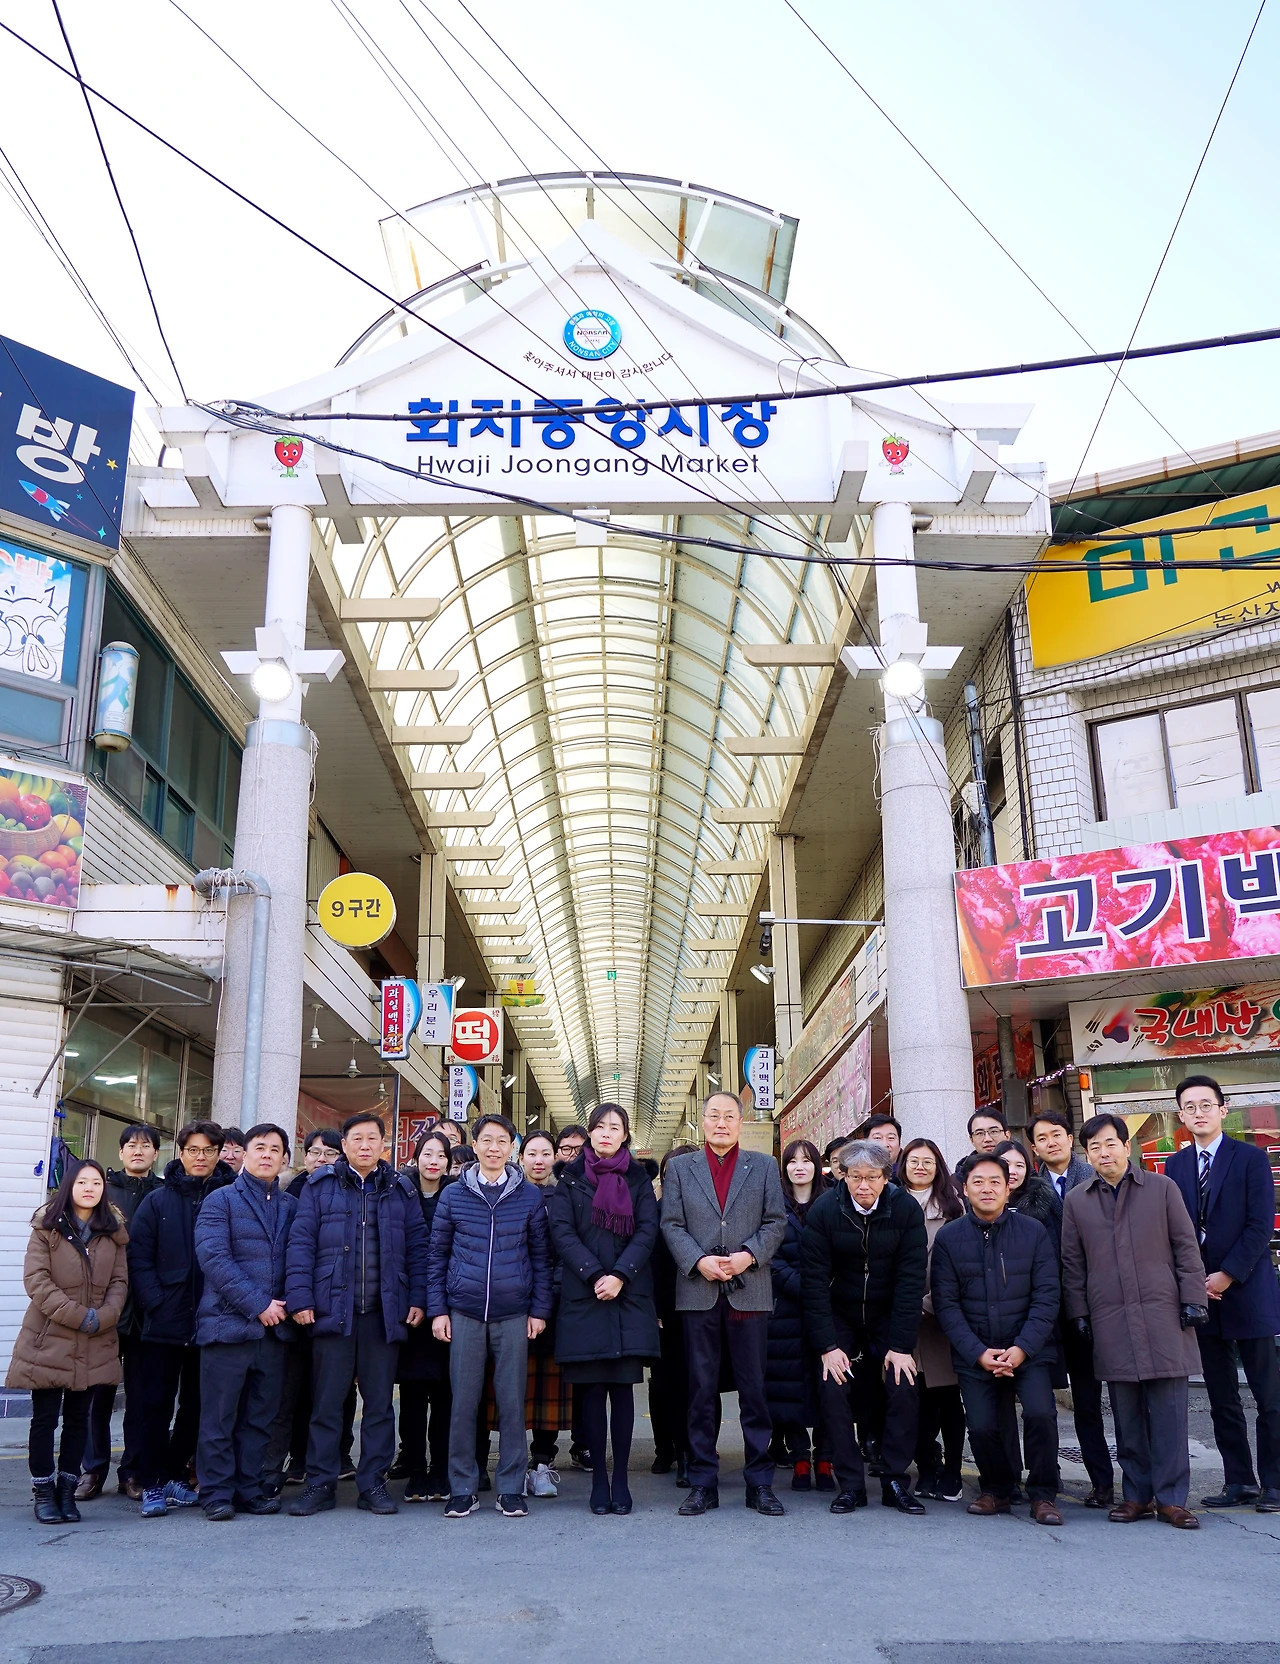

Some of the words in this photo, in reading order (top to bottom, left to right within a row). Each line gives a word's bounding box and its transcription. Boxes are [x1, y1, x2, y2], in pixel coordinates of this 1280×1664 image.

[523, 350, 576, 379] 찾아주셔서
[620, 352, 673, 379] 감사합니다
[568, 340, 602, 357] NONSAN
[601, 340, 617, 355] CITY
[16, 403, 101, 484] 방
[406, 397, 777, 449] 화지중앙시장
[417, 454, 490, 477] Hwaji
[501, 454, 648, 476] Joongang
[661, 453, 760, 474] Market
[331, 898, 381, 918] 9구간
[387, 987, 400, 1047] 과일백화점
[454, 1018, 491, 1054] 떡
[1133, 1000, 1262, 1046] 국내산
[758, 1050, 769, 1106] 고기백화점
